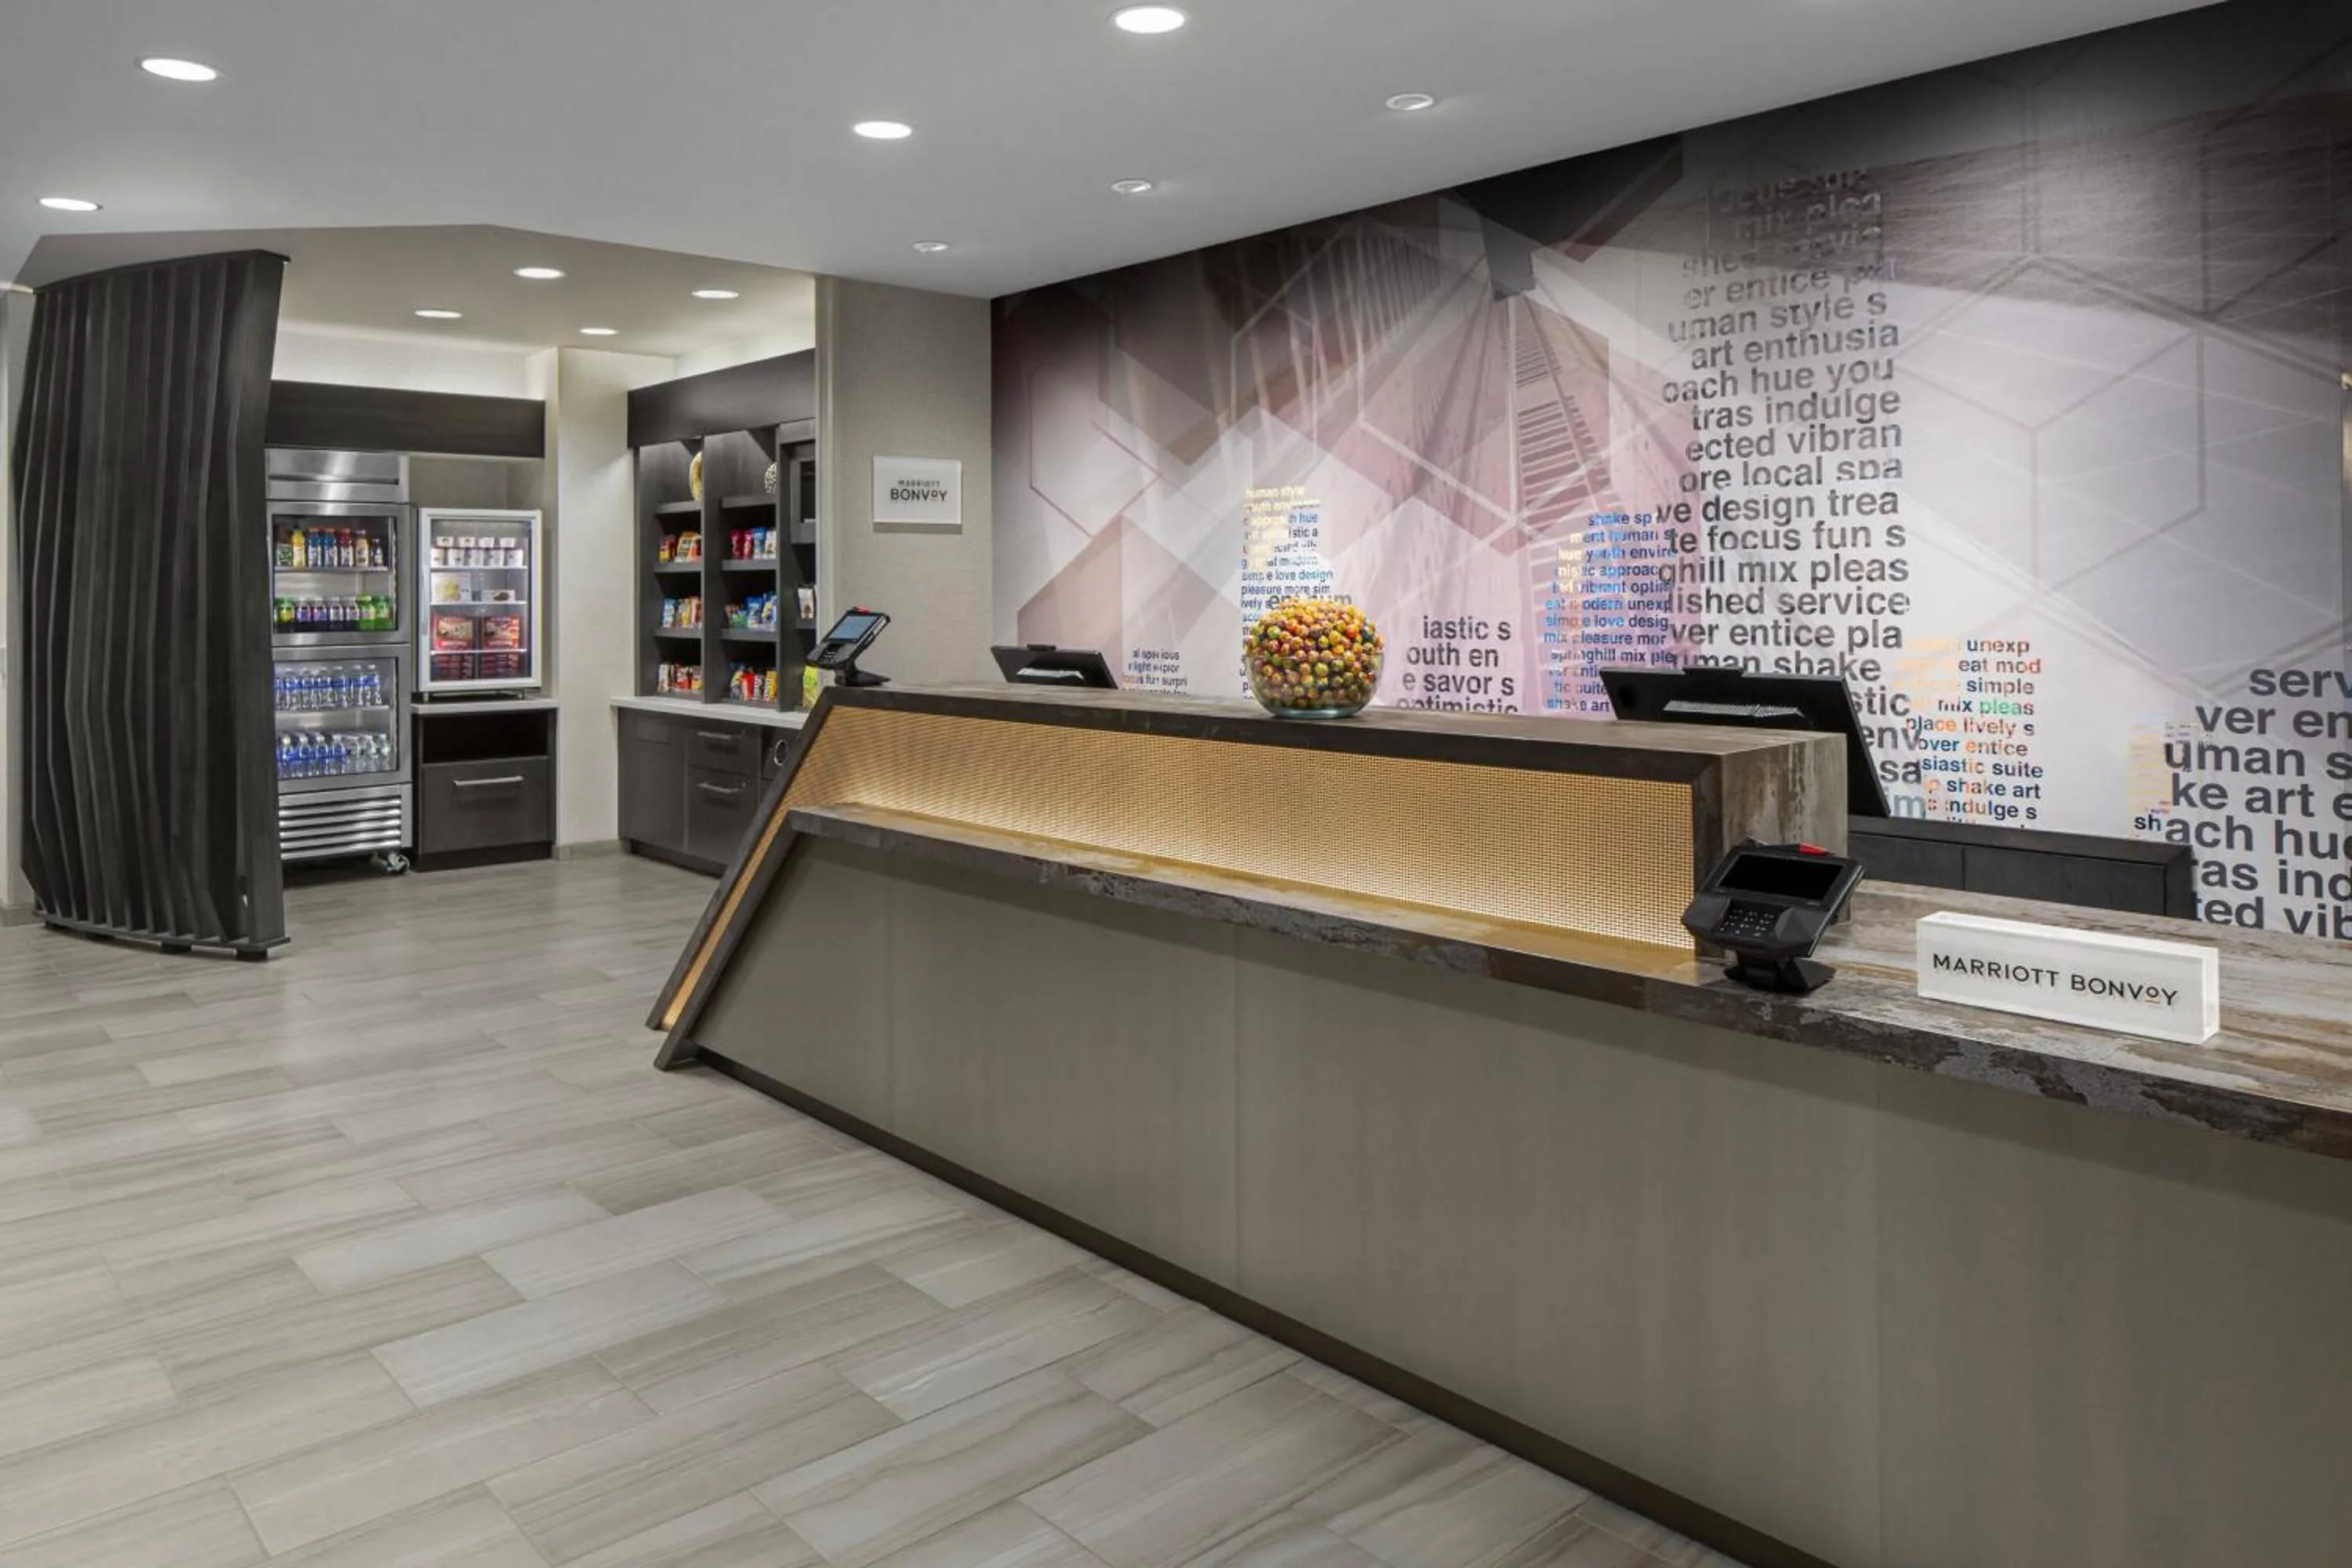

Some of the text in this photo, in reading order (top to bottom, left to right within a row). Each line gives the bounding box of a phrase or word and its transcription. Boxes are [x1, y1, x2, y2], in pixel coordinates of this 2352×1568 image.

[1725, 269, 1831, 304] entice
[1668, 290, 1887, 343] uman style s
[1691, 318, 1900, 370] art enthusia
[1751, 365, 1815, 394] hue
[1825, 357, 1895, 394] you
[1691, 387, 1901, 430] tras indulge
[1686, 420, 1903, 463] ected vibran
[1679, 467, 1733, 494] ore
[1742, 456, 1824, 487] local
[890, 488, 949, 502] BONVOY
[1656, 488, 1899, 528] ve design trea
[1707, 524, 1802, 552] focus
[1812, 520, 1873, 550] fun
[1884, 524, 1907, 548] s
[1736, 558, 1799, 584] mix
[1809, 553, 1911, 591] pleas
[1776, 585, 1910, 617] service
[1423, 615, 1512, 641] iastic s
[1594, 614, 1624, 628] love
[1671, 622, 1720, 646] ver
[1728, 618, 1836, 648] entice
[1846, 618, 1904, 656] pla
[1406, 642, 1500, 668] outh en
[1621, 648, 1646, 662] mix
[1966, 638, 2031, 657] unexp
[1773, 650, 1882, 682] shake
[1958, 658, 2042, 675] eat mod
[1402, 672, 1515, 696] e savor s
[1965, 677, 2035, 698] simple
[1979, 699, 2035, 718] pleas
[2194, 705, 2276, 735] ver
[2292, 707, 2352, 739] en
[1906, 715, 2035, 739] place lively s
[1918, 735, 2029, 757] over entice
[2164, 740, 2352, 781] uman s
[1991, 761, 2045, 779] suite
[1946, 777, 2007, 797] shake
[2013, 782, 2041, 800] art
[2171, 771, 2229, 811] ke
[2244, 782, 2316, 818] art
[2025, 804, 2038, 820] s
[2133, 812, 2161, 832] sh
[2165, 814, 2255, 852] ach
[1933, 953, 2180, 1007] MARRIOTT BONVOY
